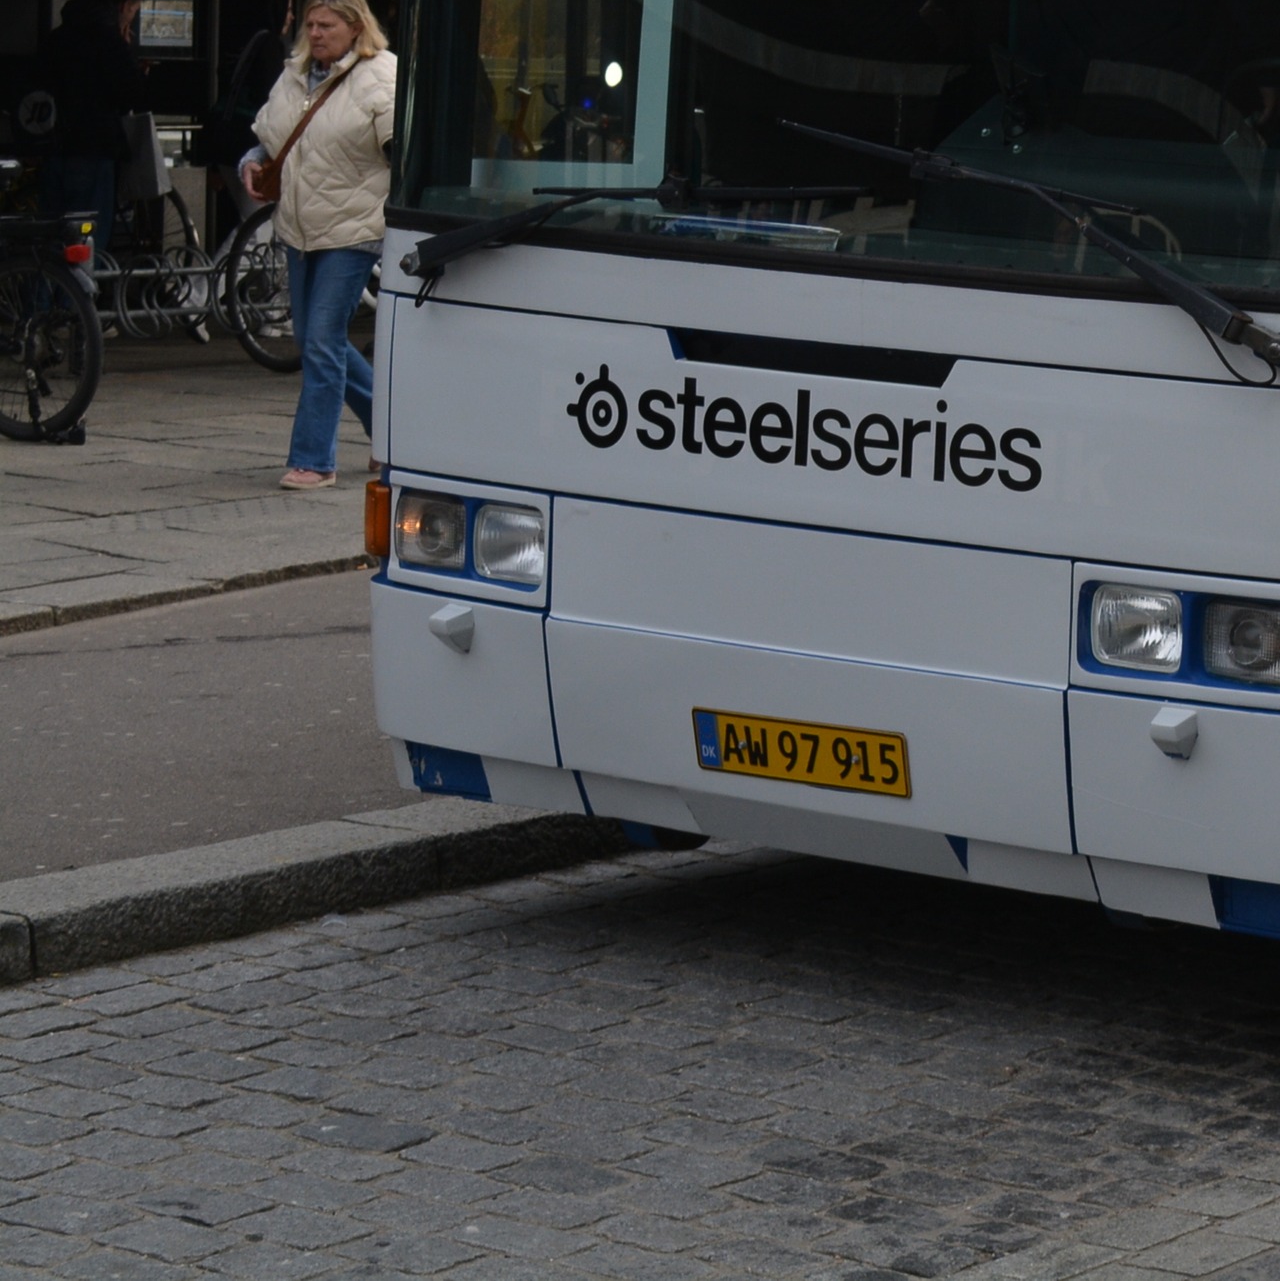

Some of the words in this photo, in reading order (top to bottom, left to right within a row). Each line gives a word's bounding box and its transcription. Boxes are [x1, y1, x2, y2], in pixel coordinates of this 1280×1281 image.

[636, 375, 1042, 492] steelseries
[702, 744, 717, 759] DK
[724, 723, 769, 768] AW
[777, 730, 820, 774] 97
[832, 737, 899, 785] 915
